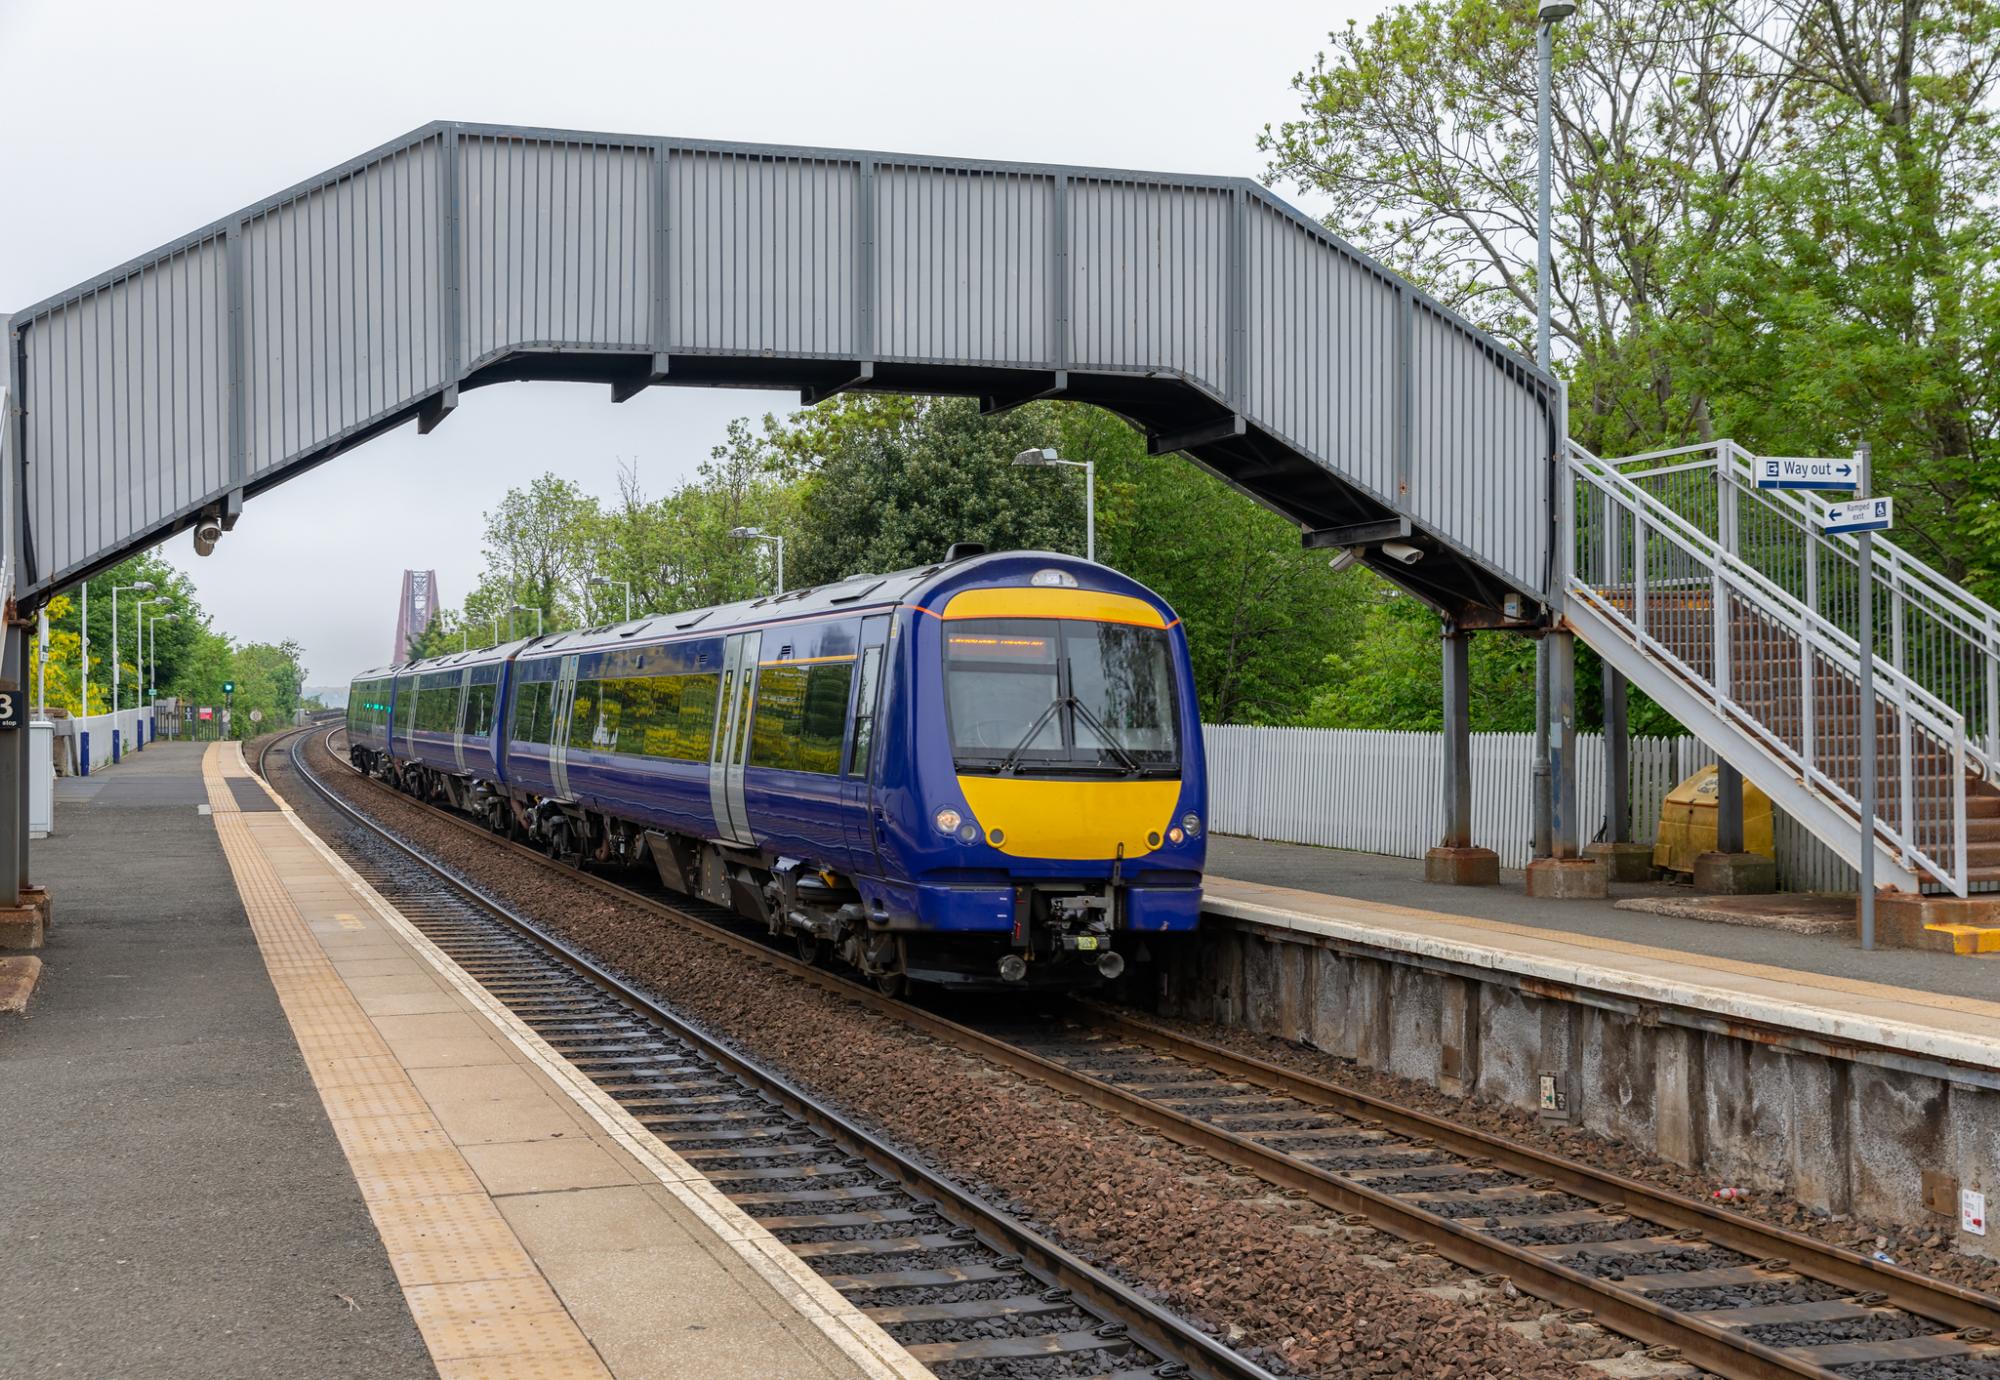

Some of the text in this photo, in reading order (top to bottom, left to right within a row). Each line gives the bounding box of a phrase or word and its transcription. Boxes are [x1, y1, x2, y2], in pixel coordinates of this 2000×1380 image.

[1784, 461, 1832, 478] Way out
[1846, 502, 1870, 512] Ramped
[1852, 513, 1864, 521] exit
[0, 693, 13, 719] 3
